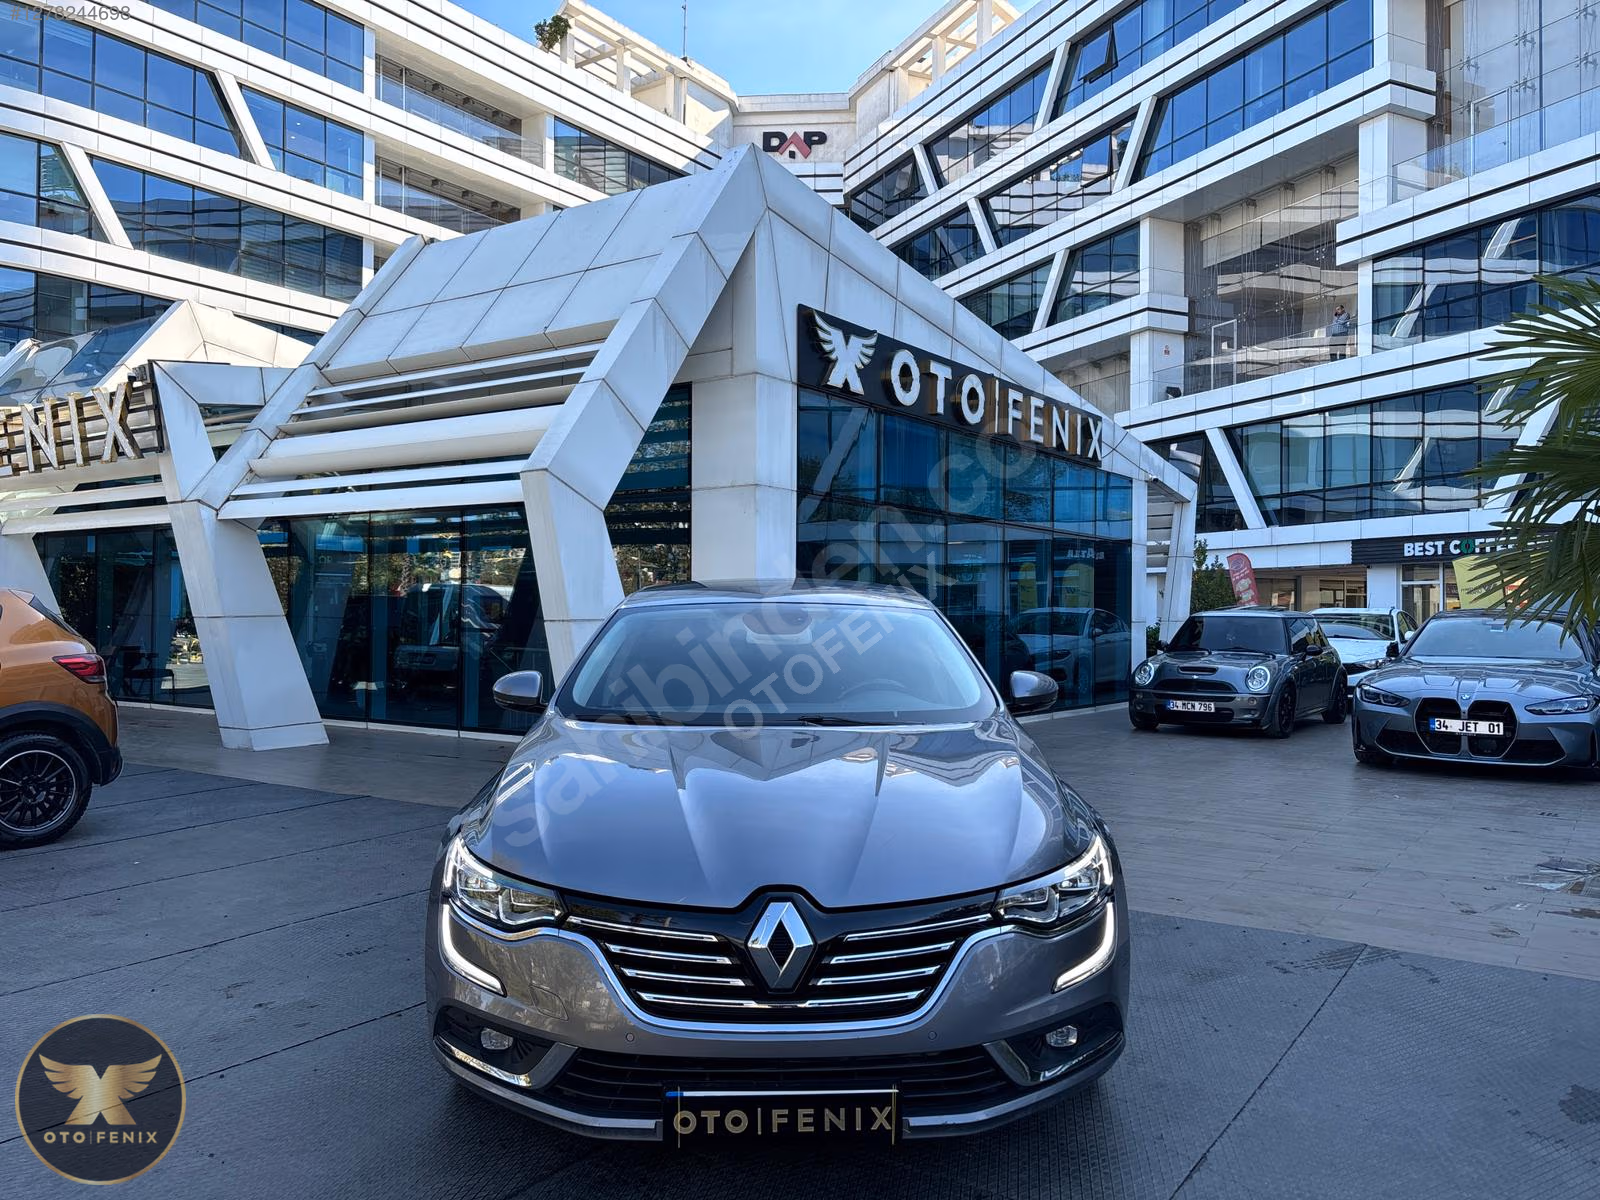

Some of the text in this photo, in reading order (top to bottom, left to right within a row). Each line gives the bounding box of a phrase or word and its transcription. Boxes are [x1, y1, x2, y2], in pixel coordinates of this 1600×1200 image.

[763, 131, 828, 159] DAP
[1403, 540, 1445, 557] BEST
[1170, 701, 1213, 712] 34 MCN 796
[1435, 719, 1449, 731] 34
[1458, 721, 1479, 733] JET
[1488, 722, 1501, 734] 01
